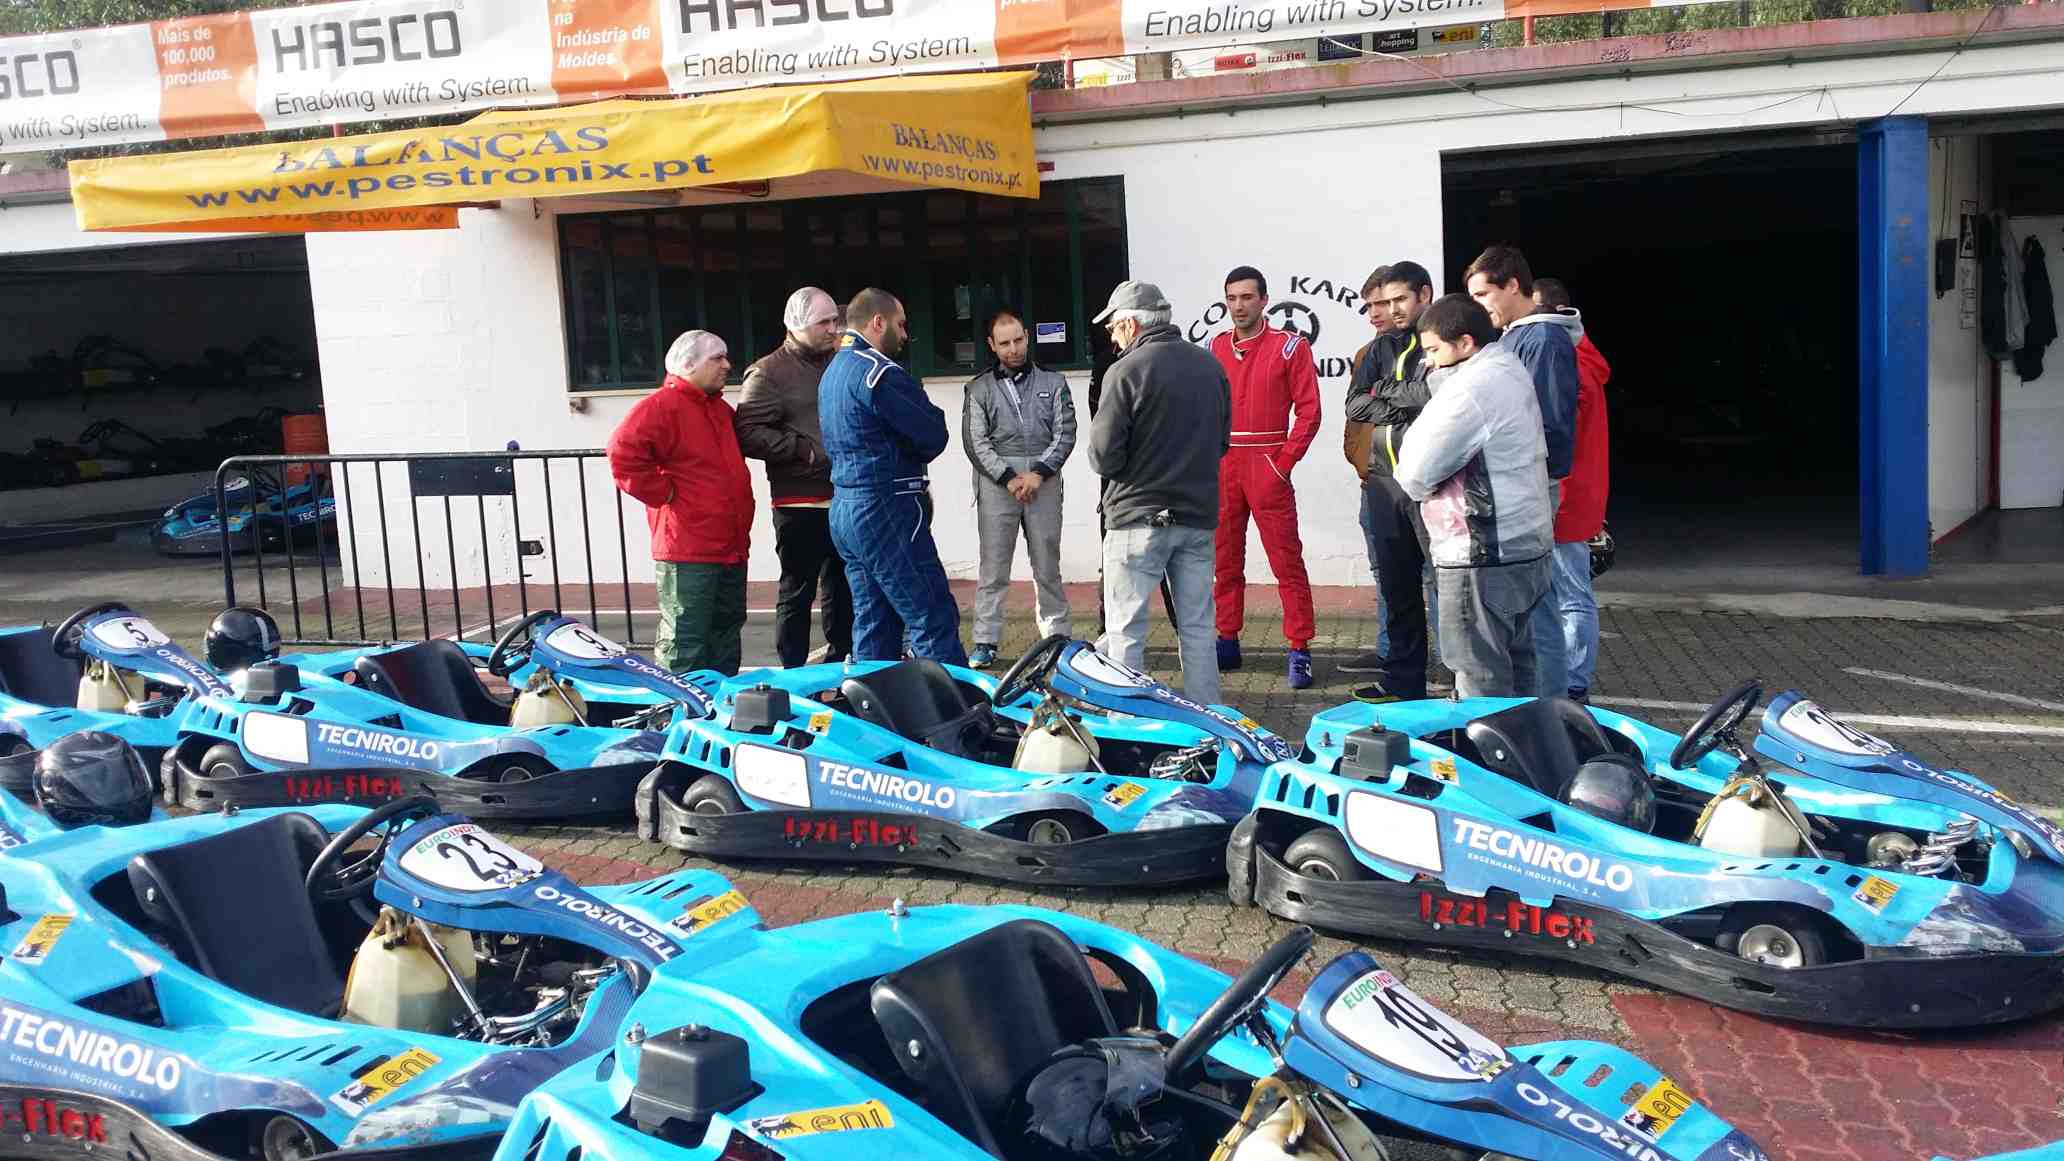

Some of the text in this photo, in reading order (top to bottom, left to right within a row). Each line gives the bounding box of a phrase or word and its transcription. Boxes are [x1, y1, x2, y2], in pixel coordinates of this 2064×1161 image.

[158, 27, 213, 45] Mais de
[554, 12, 574, 26] na
[557, 24, 651, 48] Indústria de
[1145, 5, 1275, 37] Enabling
[1286, 0, 1345, 25] with
[161, 46, 216, 65] 100.000
[271, 10, 462, 72] HASCO
[683, 35, 978, 77] Enabling with System.
[165, 66, 233, 88] produtos.
[276, 75, 537, 116] Enabling with System.
[8, 115, 52, 140] with
[59, 112, 147, 140] System.
[891, 122, 998, 163] BALANÇAS
[273, 126, 609, 174] BALANÇAS
[186, 154, 715, 208] www.pestronix.pt
[863, 153, 1023, 190] www.pestronix.pt
[122, 622, 151, 644] 5
[574, 629, 609, 652] 9
[624, 658, 708, 702] TECNIROLO
[317, 723, 438, 760] TECNIROLO
[819, 761, 956, 809] TECNIROLO
[415, 825, 477, 855] EUROINDY
[437, 833, 518, 882] 23
[1453, 818, 1633, 892] TECNIROLO
[1468, 852, 1522, 873] ENGENHARIA
[534, 886, 677, 961] TECNIROLO
[1372, 986, 1469, 1062] 19
[0, 1007, 181, 1091] TECNIROLO
[382, 1049, 434, 1087] eni
[811, 1100, 885, 1132] eni
